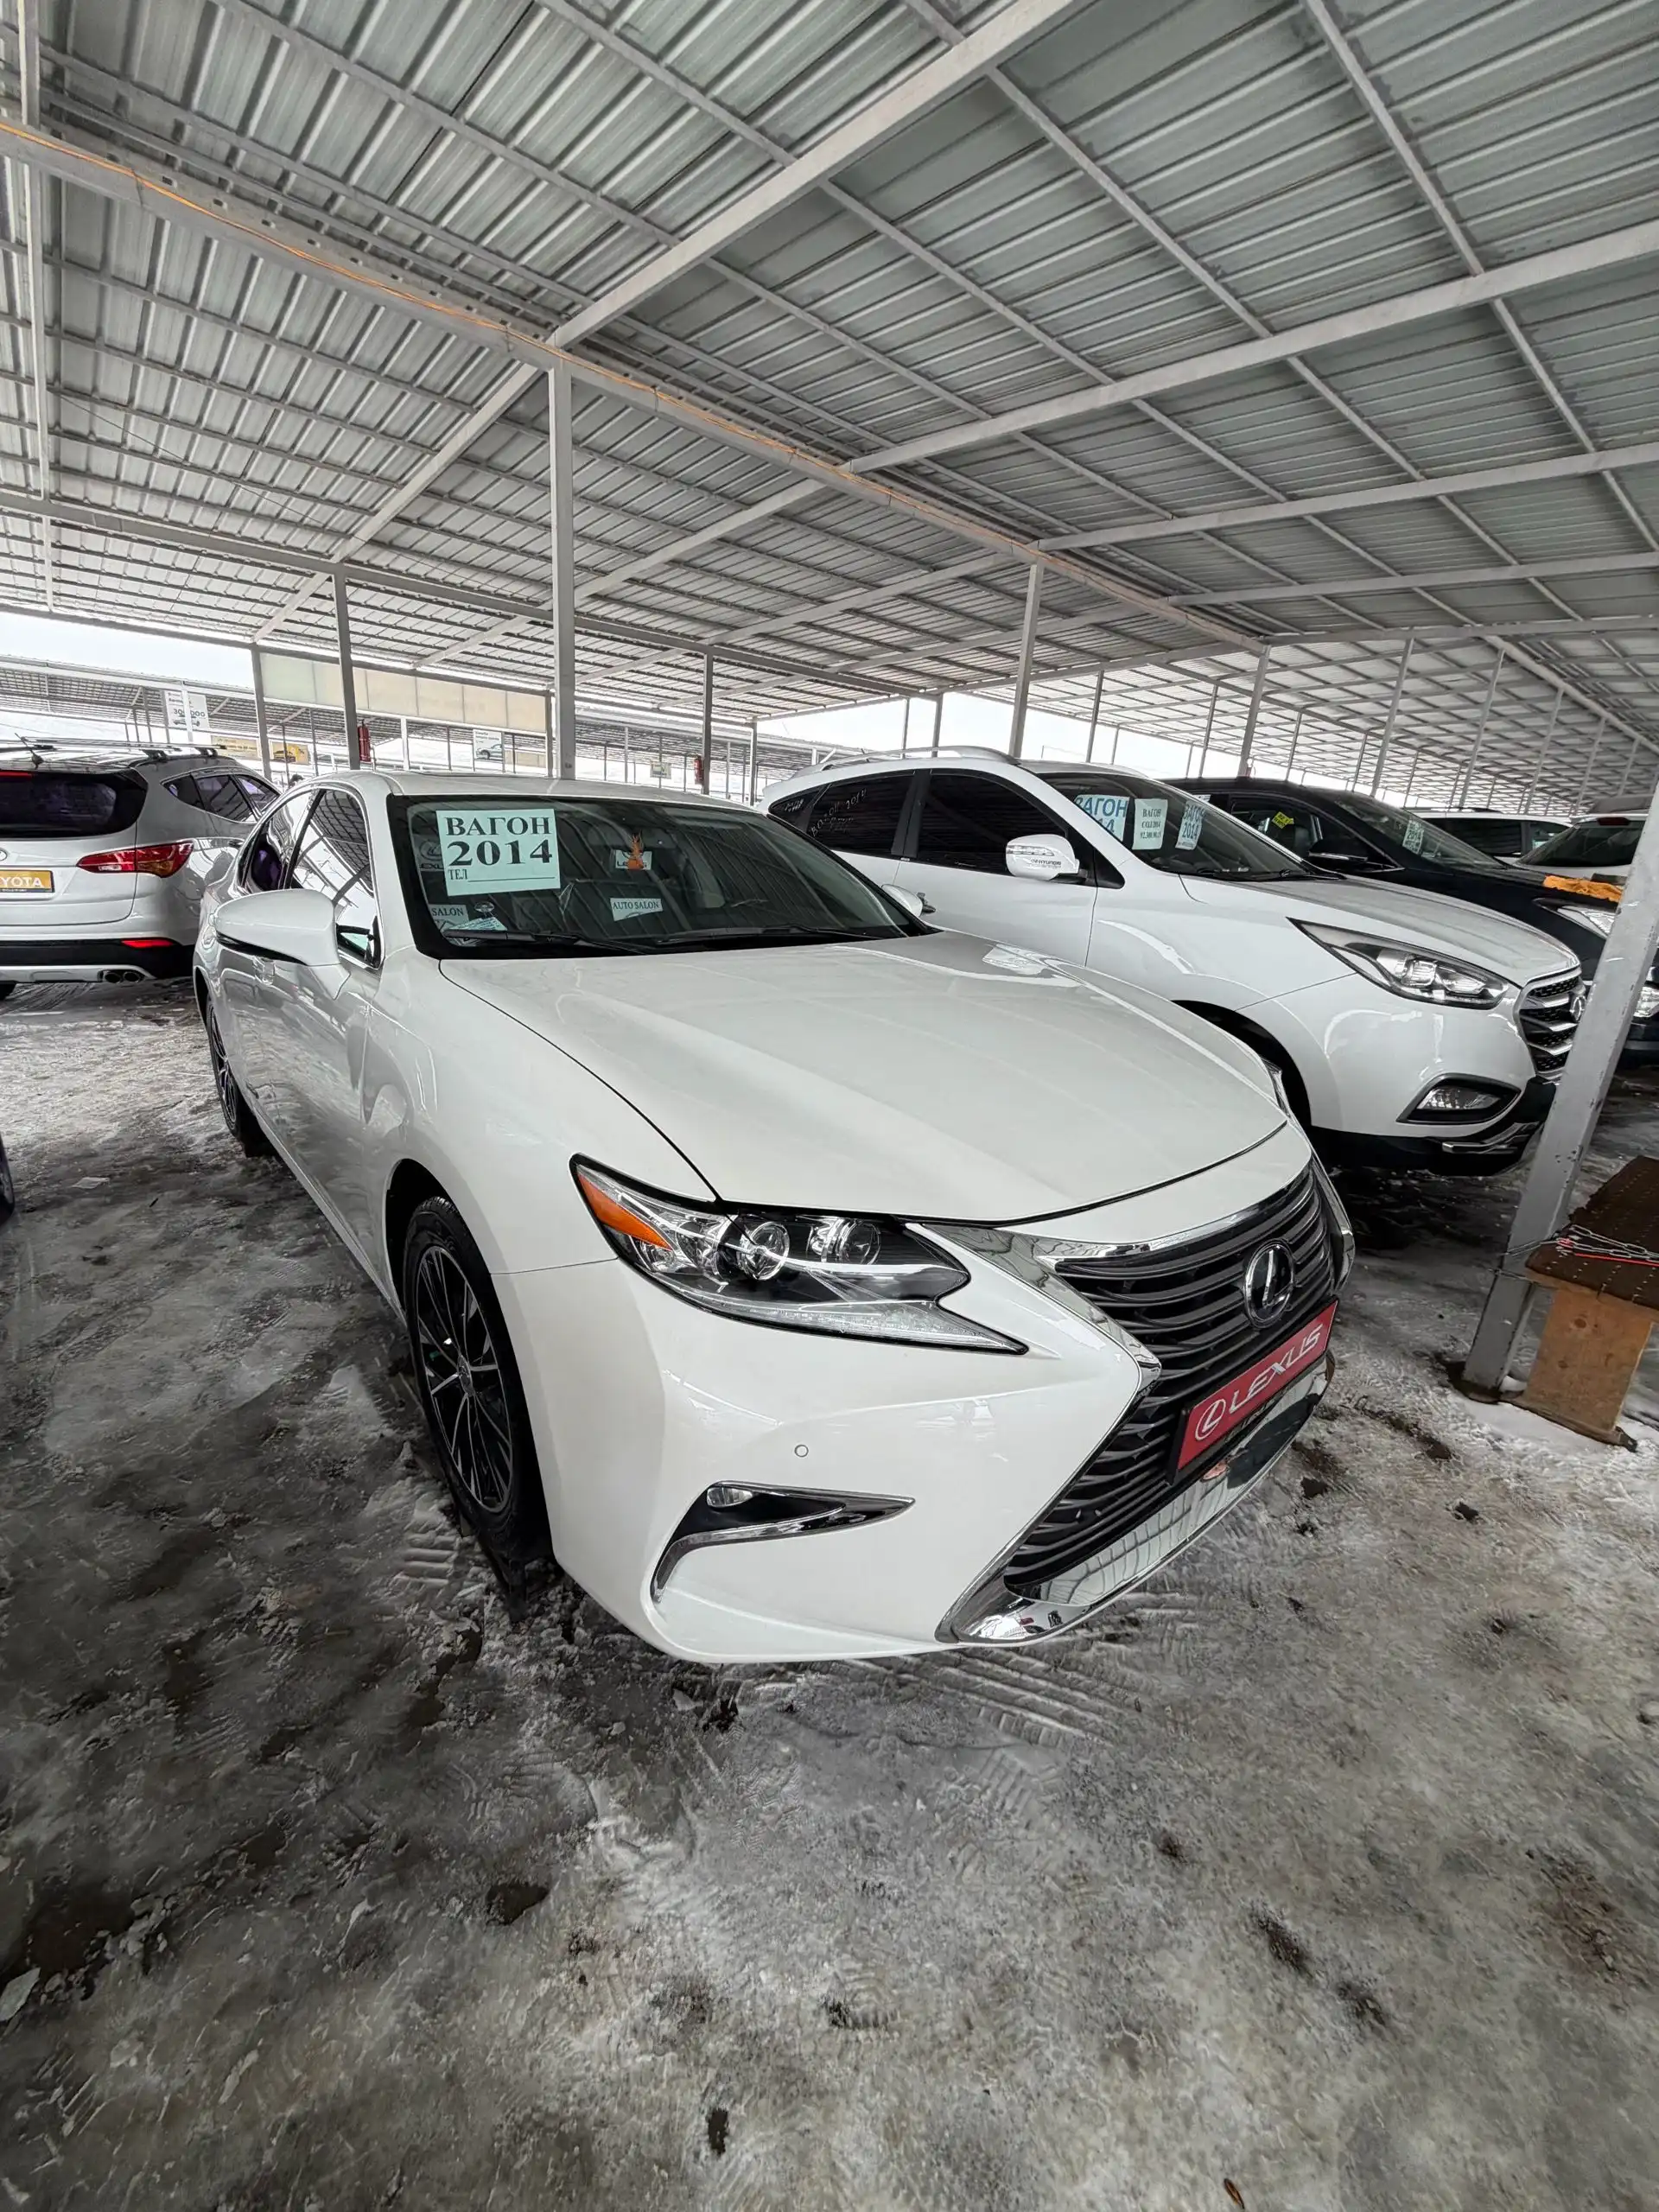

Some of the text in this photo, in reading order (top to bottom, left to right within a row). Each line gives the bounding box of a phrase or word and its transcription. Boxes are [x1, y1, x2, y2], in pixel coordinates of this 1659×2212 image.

[445, 816, 552, 836] ВАГОН
[1182, 822, 1198, 841] 2014
[447, 839, 553, 867] 2014
[448, 868, 468, 880] ТЕЛ
[432, 907, 465, 917] SALON
[613, 900, 660, 910] AUTO SALON
[1229, 1323, 1324, 1414] LEXUS
